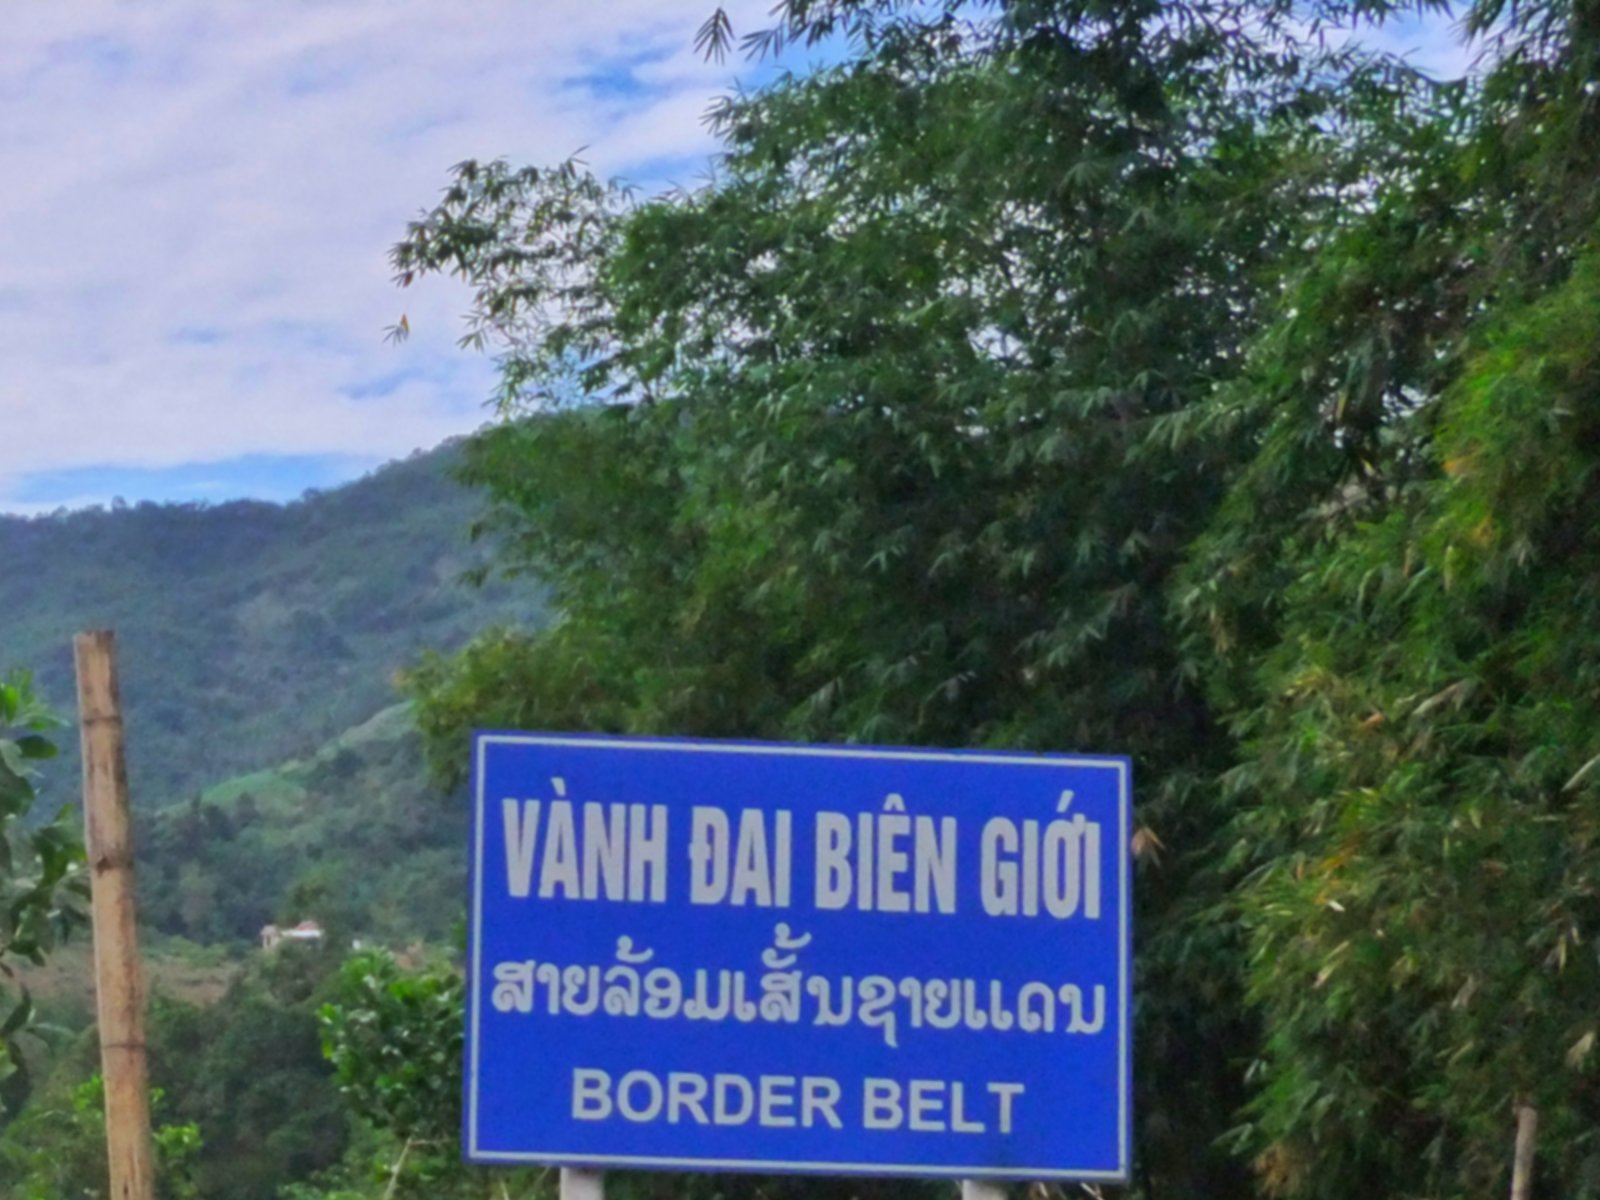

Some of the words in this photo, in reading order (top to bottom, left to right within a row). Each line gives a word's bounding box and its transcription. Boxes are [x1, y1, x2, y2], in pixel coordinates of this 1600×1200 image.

[502, 777, 668, 902] VÀNH
[689, 805, 792, 908] ĐAI
[815, 793, 957, 914] BIÊN
[980, 790, 1101, 920] GIỚI
[571, 1067, 843, 1130] BORDER
[863, 1078, 1026, 1134] BELT
